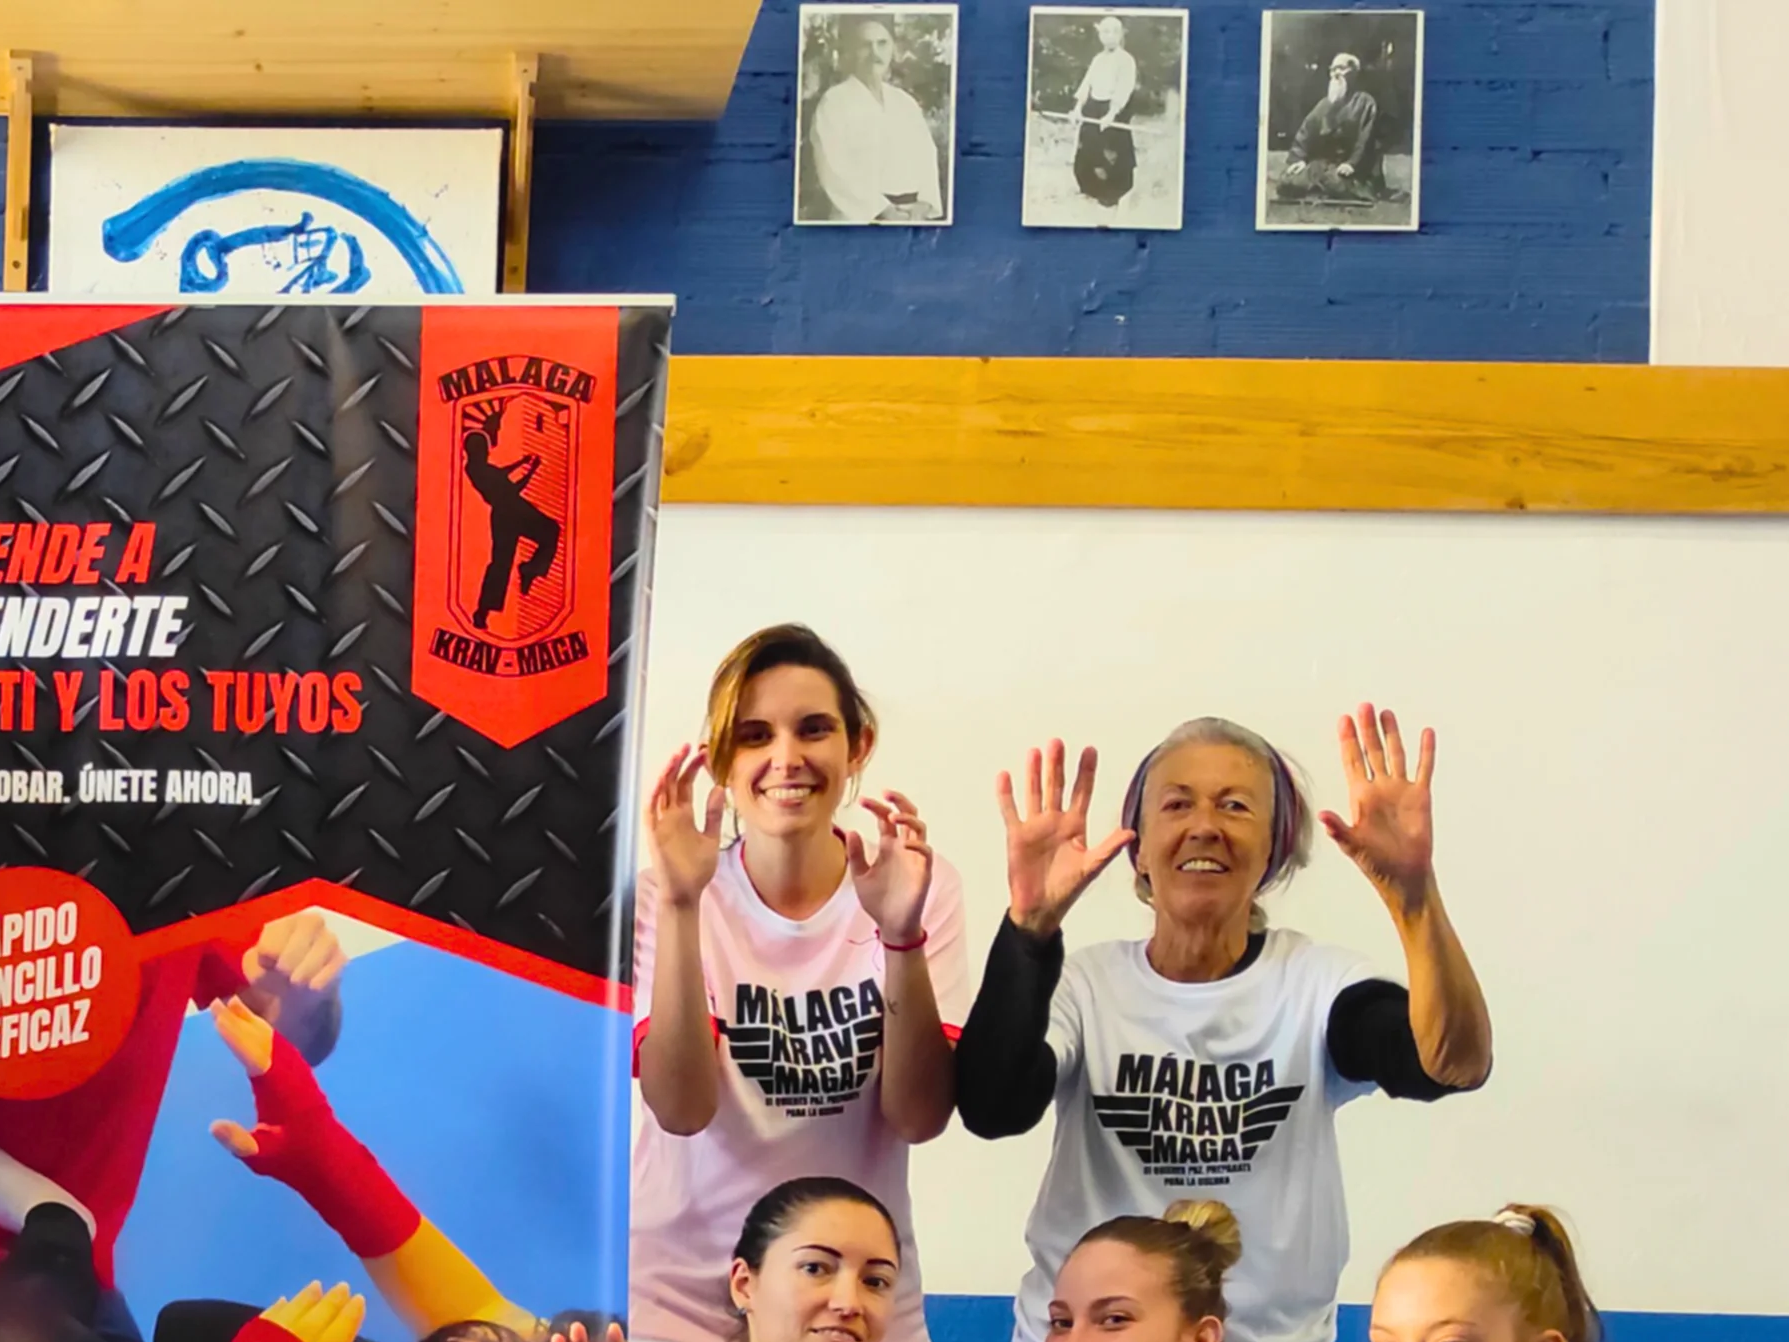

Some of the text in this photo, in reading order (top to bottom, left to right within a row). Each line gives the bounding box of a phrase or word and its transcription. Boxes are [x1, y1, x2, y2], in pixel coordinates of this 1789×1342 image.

[439, 356, 594, 403] MALAGA
[114, 522, 157, 584] A
[52, 670, 84, 733] Y
[98, 668, 191, 732] LOS
[206, 670, 364, 735] TUYOS
[78, 761, 158, 804] ÚNETE
[164, 769, 262, 806] AHORA.
[775, 1059, 855, 1095] MAGA
[1115, 1052, 1276, 1103] MÁLAGA
[1150, 1096, 1241, 1136] KRAV
[1152, 1134, 1241, 1164] MAGA
